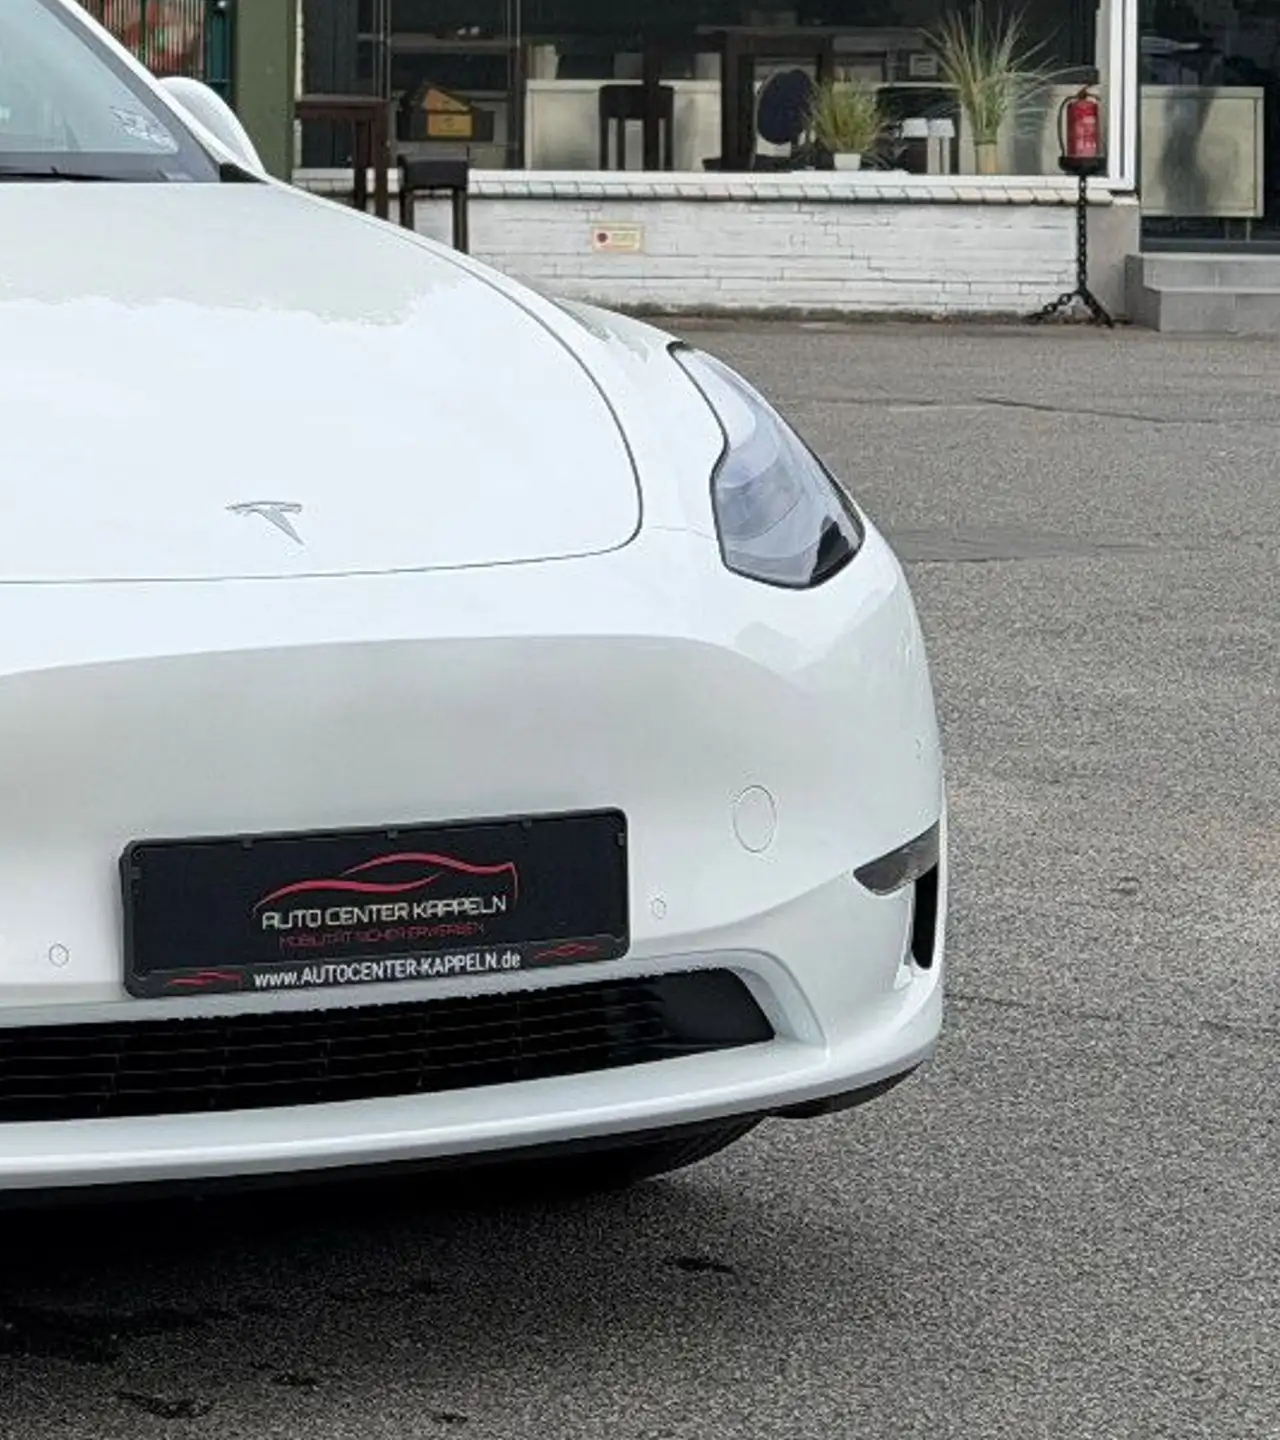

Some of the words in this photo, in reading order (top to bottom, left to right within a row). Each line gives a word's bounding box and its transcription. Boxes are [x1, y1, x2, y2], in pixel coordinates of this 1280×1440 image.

[261, 909, 322, 931] AUTO
[325, 903, 409, 927] CENTER
[412, 894, 507, 920] KAPPELN
[253, 949, 522, 989] www.AUTOCENTER-KAPPELN.de
